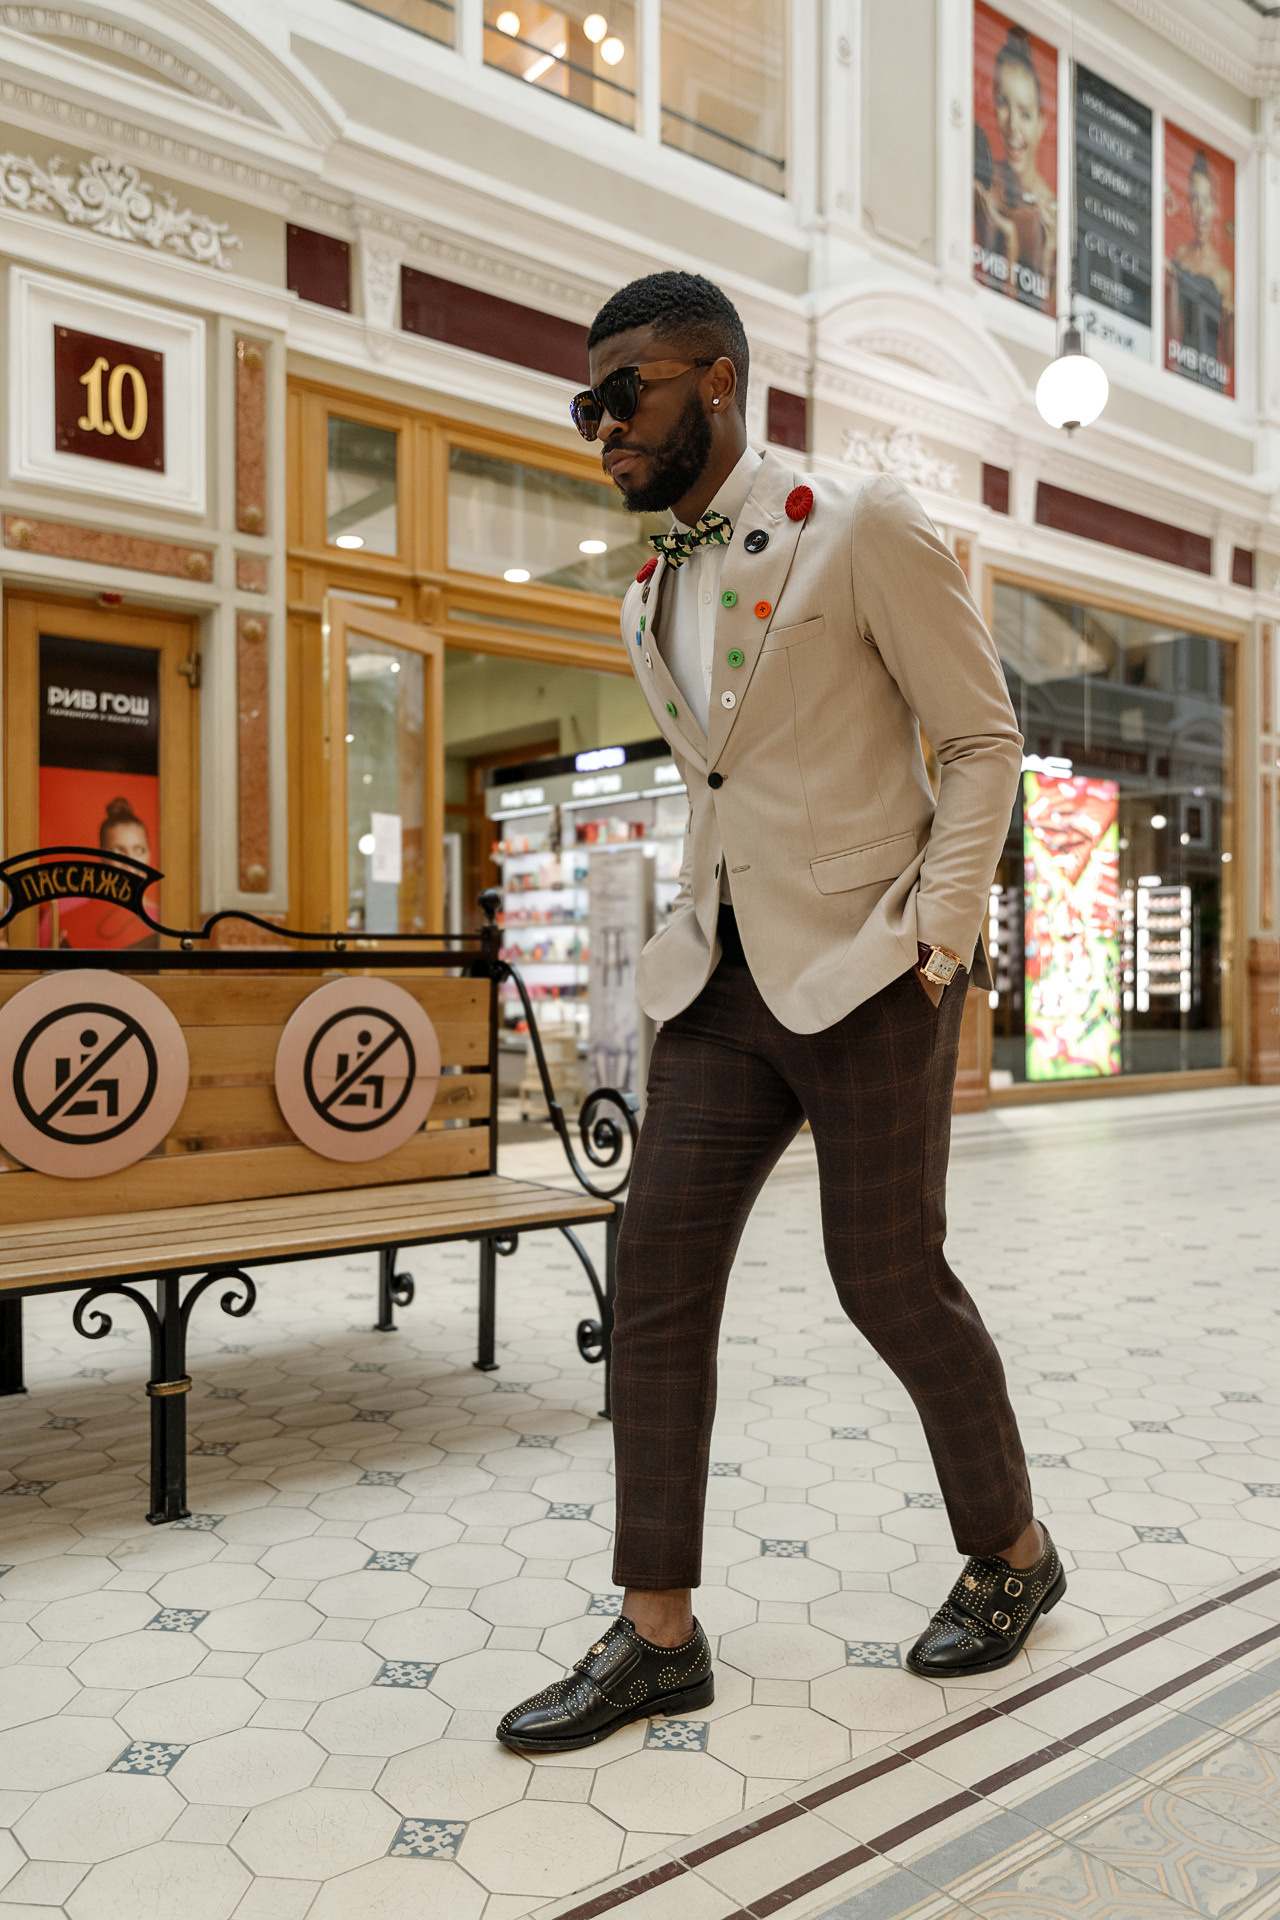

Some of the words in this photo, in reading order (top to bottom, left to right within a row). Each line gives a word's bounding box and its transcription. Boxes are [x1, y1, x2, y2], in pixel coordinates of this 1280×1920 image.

[77, 356, 149, 441] 10
[47, 685, 97, 711] РИВ
[99, 691, 149, 717] ГОШ
[20, 866, 132, 902] ПАССАЖЪ
